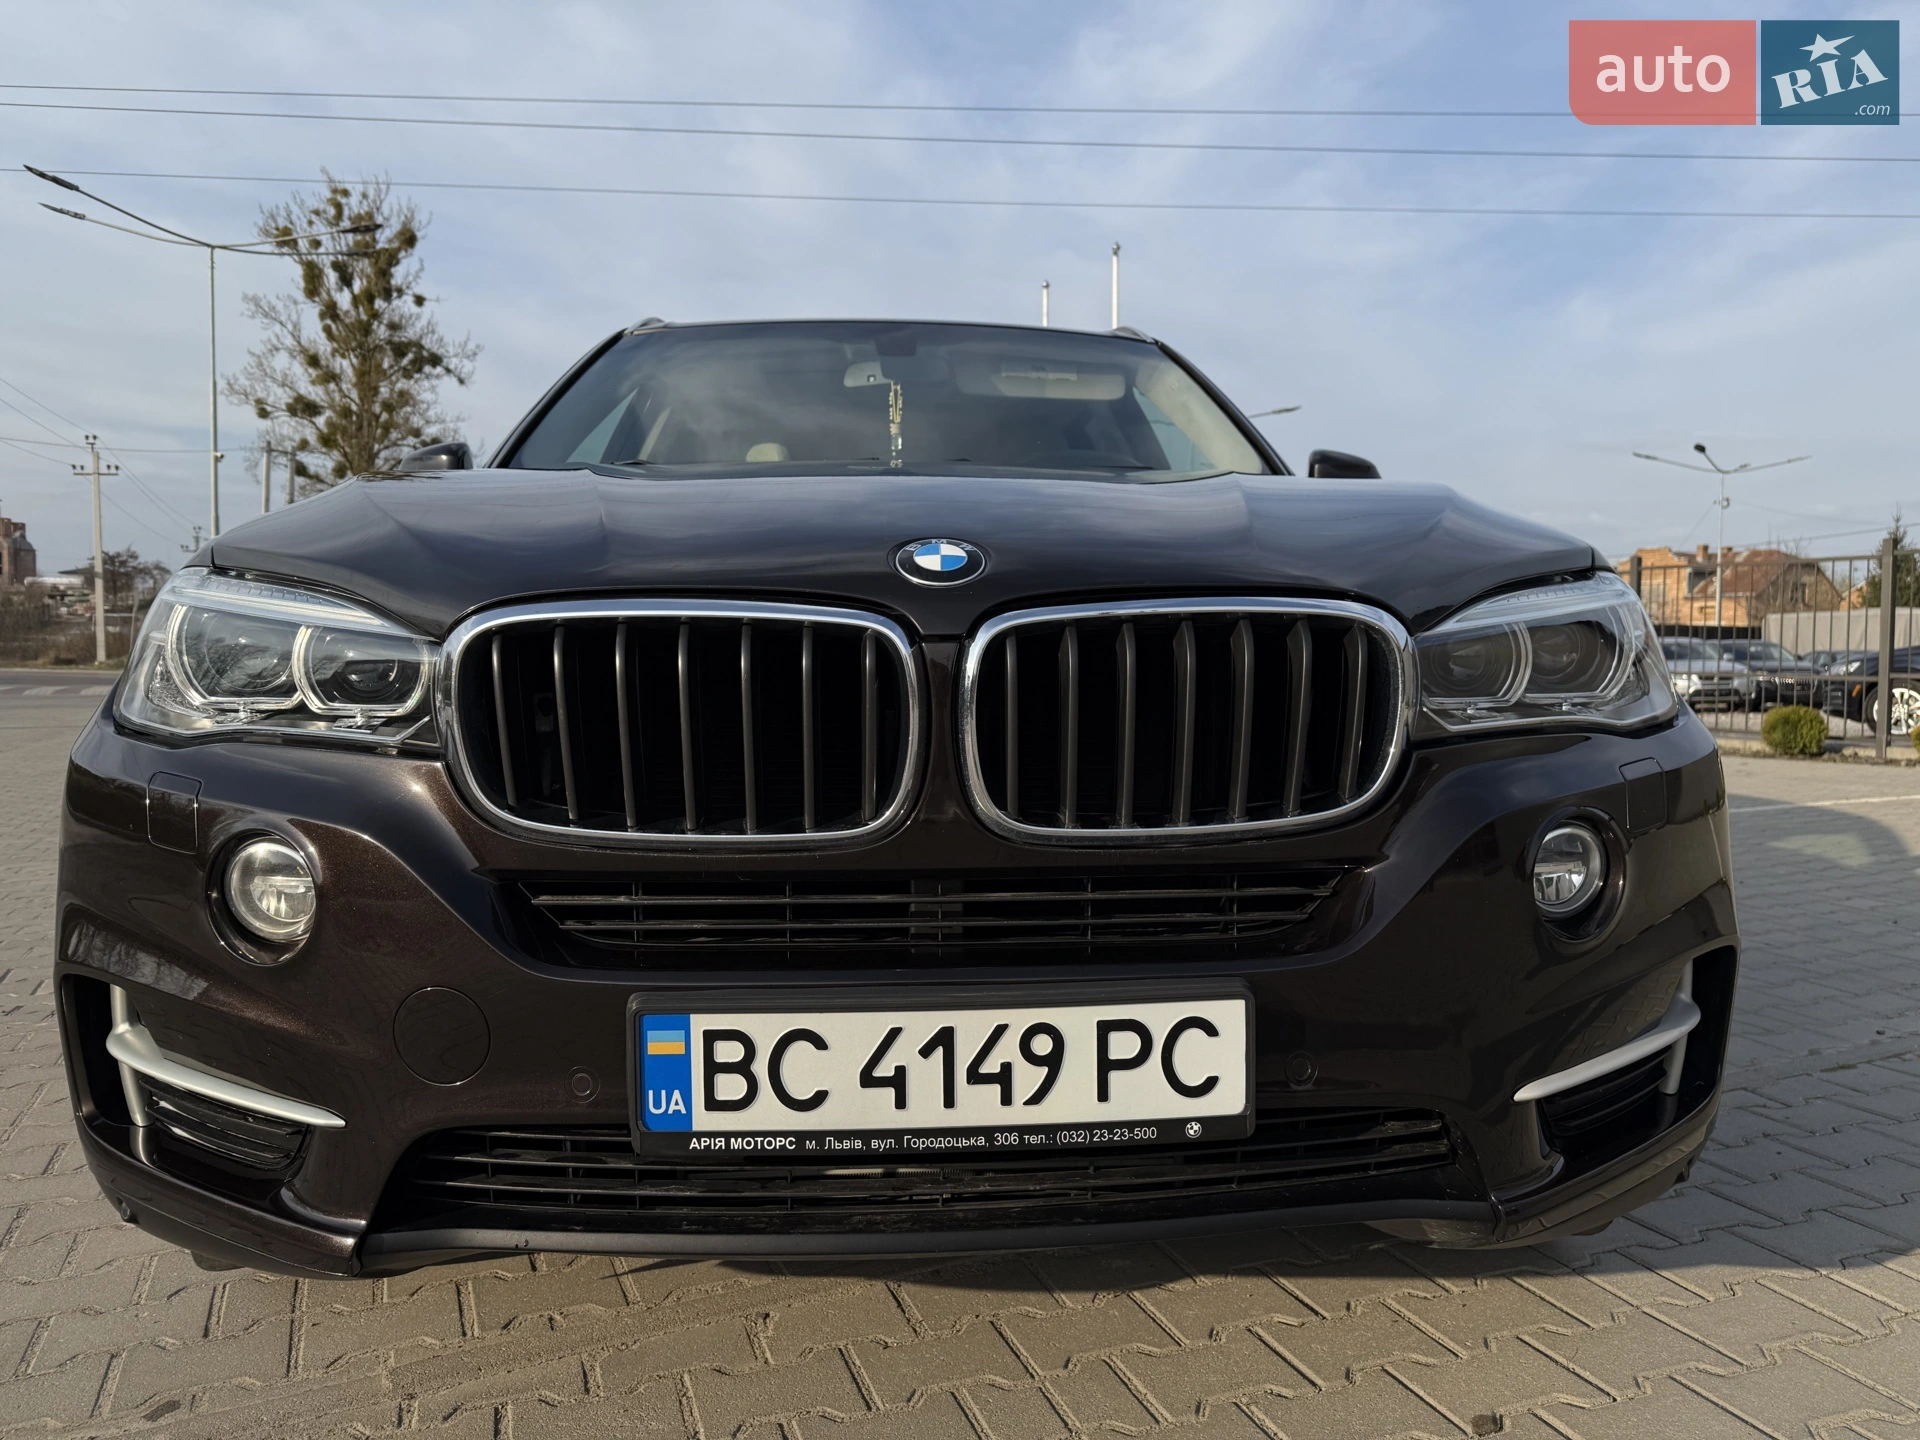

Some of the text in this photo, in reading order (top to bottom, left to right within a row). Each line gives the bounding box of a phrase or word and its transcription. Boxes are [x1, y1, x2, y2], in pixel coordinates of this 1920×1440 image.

[905, 539, 976, 551] BMW
[703, 1015, 1220, 1112] BC 4149 PC
[648, 1089, 687, 1115] UA
[689, 1126, 1157, 1151] АРІЯ МОТОРС м. Львів, вул. Городоцька, 306 тел.: (032) 23-23-500
